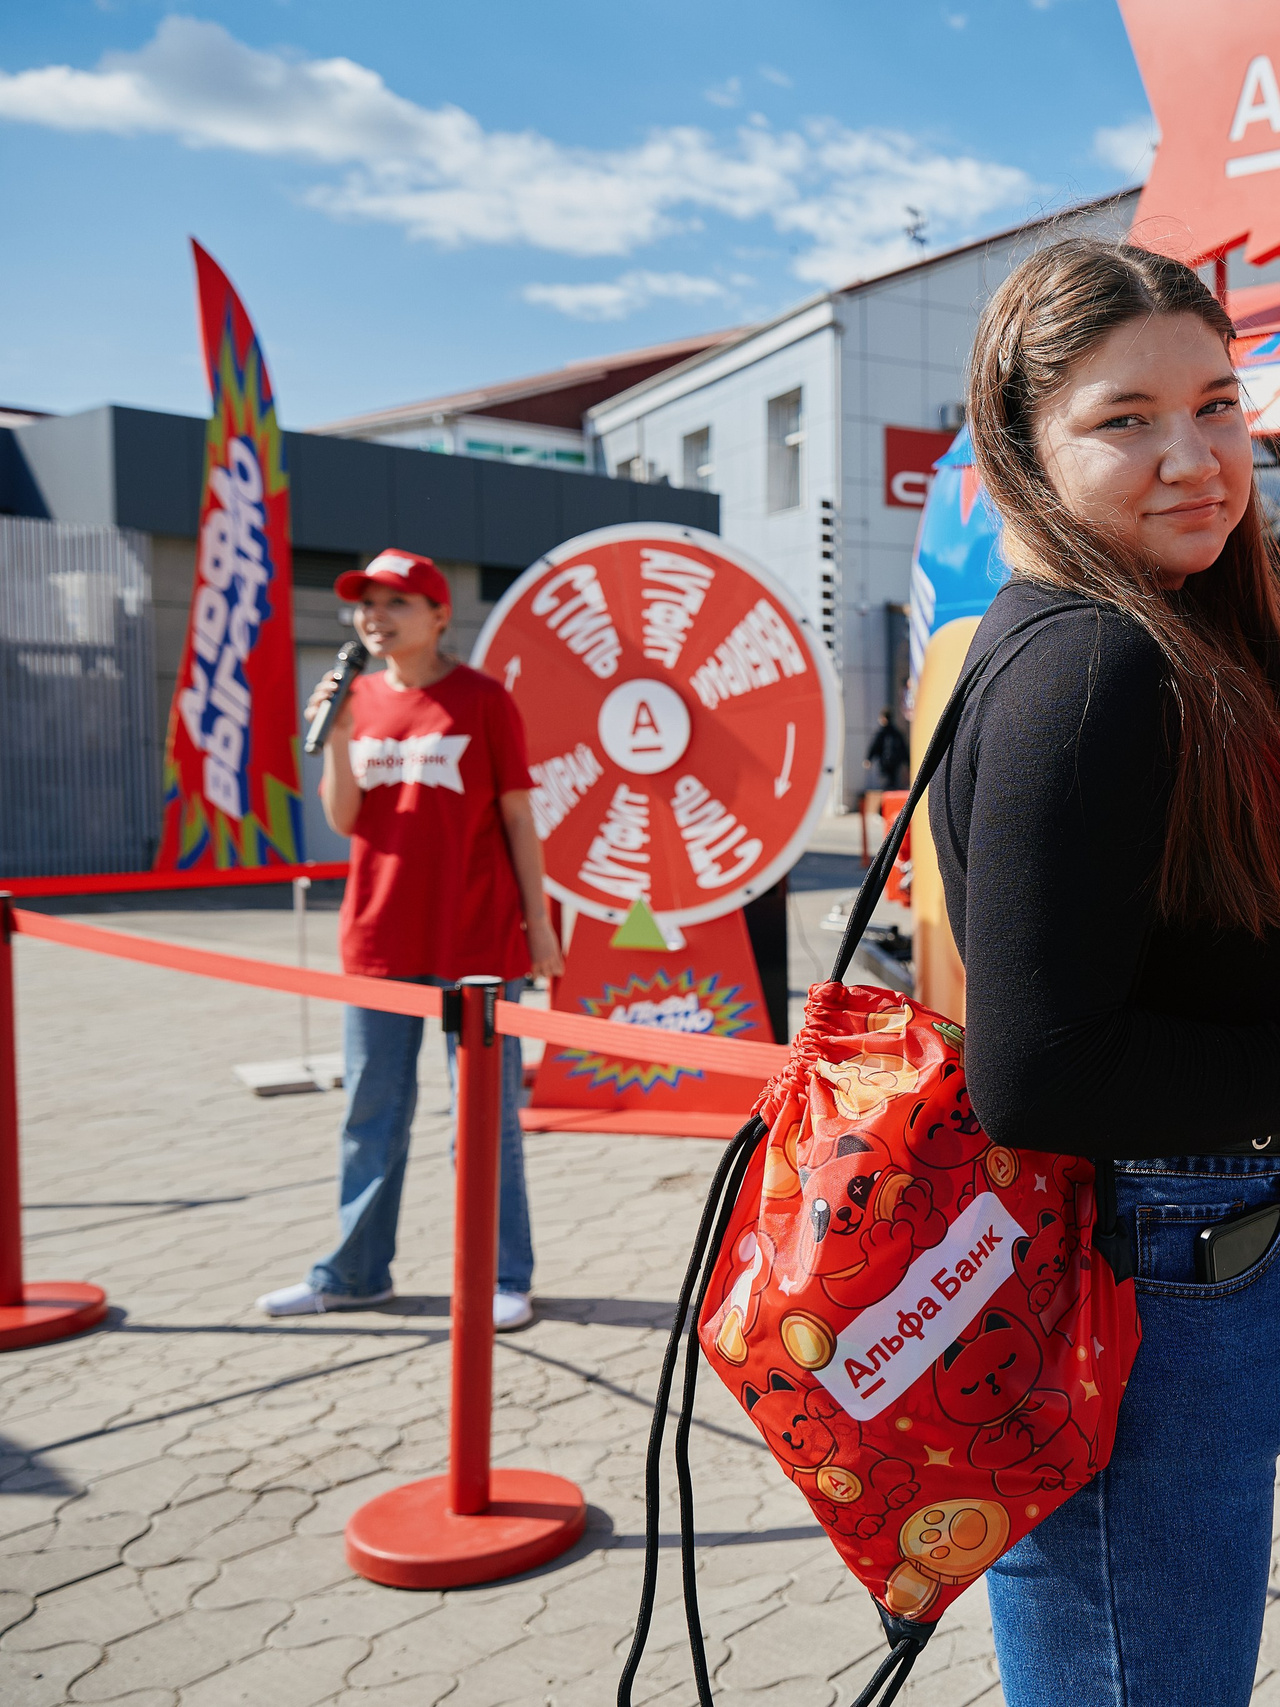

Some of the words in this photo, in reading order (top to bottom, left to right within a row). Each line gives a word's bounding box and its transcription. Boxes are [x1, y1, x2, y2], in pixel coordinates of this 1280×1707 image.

[531, 563, 623, 679] СТИЛЬ
[640, 547, 716, 670] АУТФИТ
[688, 598, 807, 711] ВЫБИРАЙ
[577, 782, 652, 903] АУТФИТ
[669, 773, 764, 890] СТИЛЬ
[844, 1296, 943, 1390] Альфа
[930, 1223, 1004, 1301] Банк
